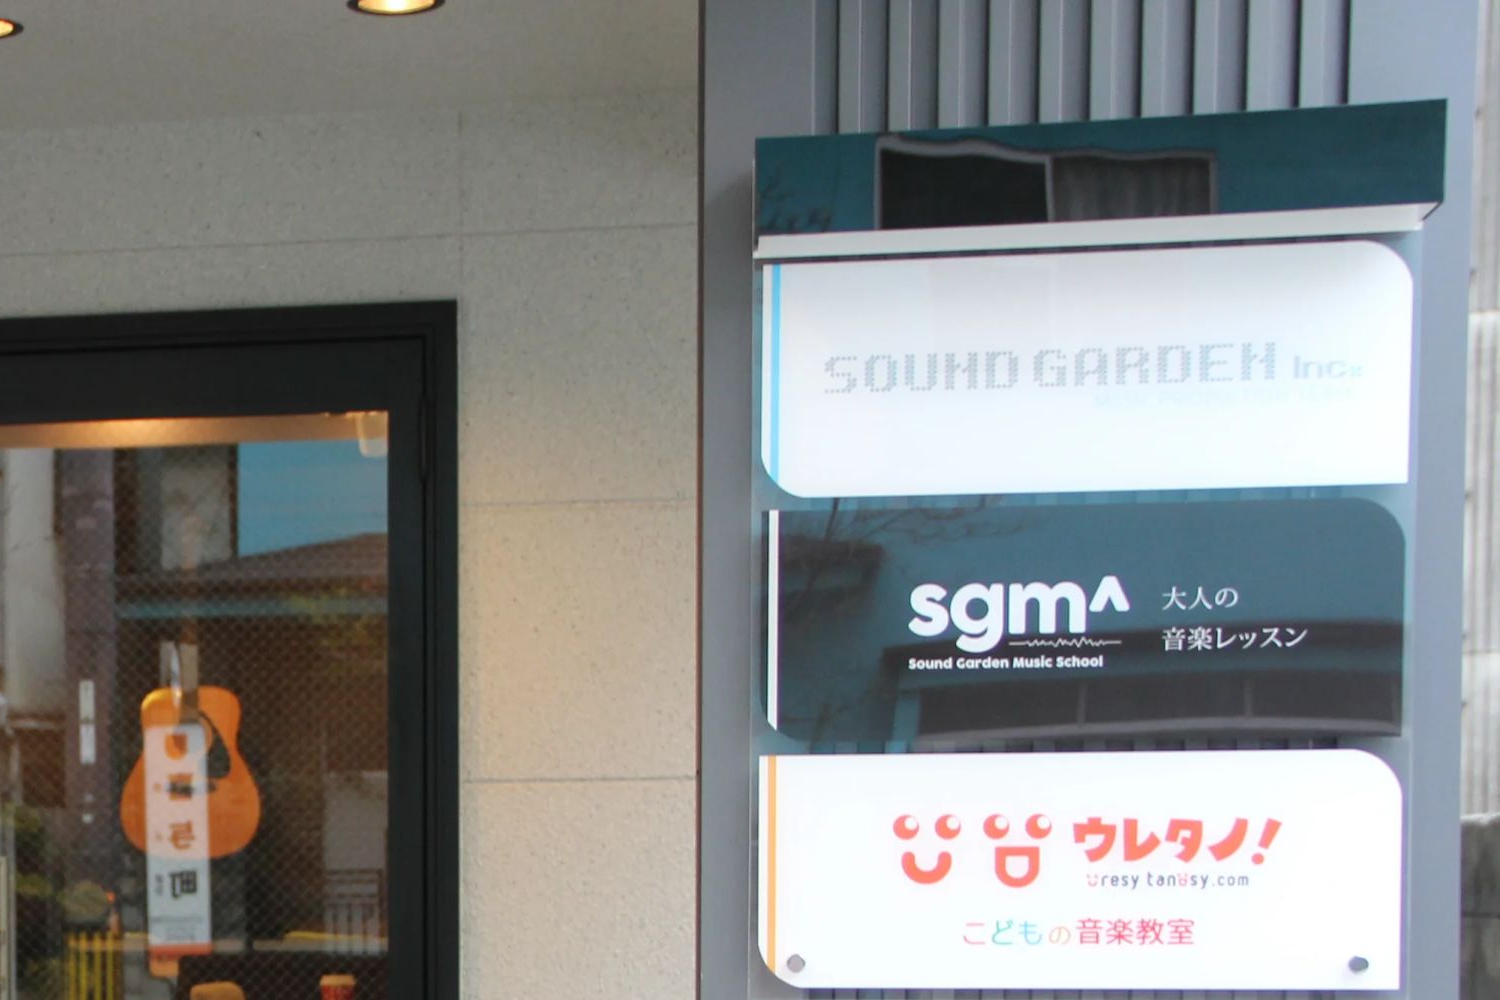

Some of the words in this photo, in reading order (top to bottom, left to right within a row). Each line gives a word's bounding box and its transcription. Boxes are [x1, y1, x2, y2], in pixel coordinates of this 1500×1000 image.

[824, 350, 1019, 395] SOUND
[1033, 341, 1277, 388] GARDEN
[1161, 585, 1240, 612] 大人の
[1161, 626, 1308, 652] 音楽レッスン
[908, 656, 953, 670] Sound
[956, 655, 1009, 670] Garden
[1012, 655, 1053, 669] Music
[1056, 654, 1104, 669] School
[1073, 815, 1283, 866] ウレタノ!
[962, 917, 1197, 947] こどもの音楽教室
